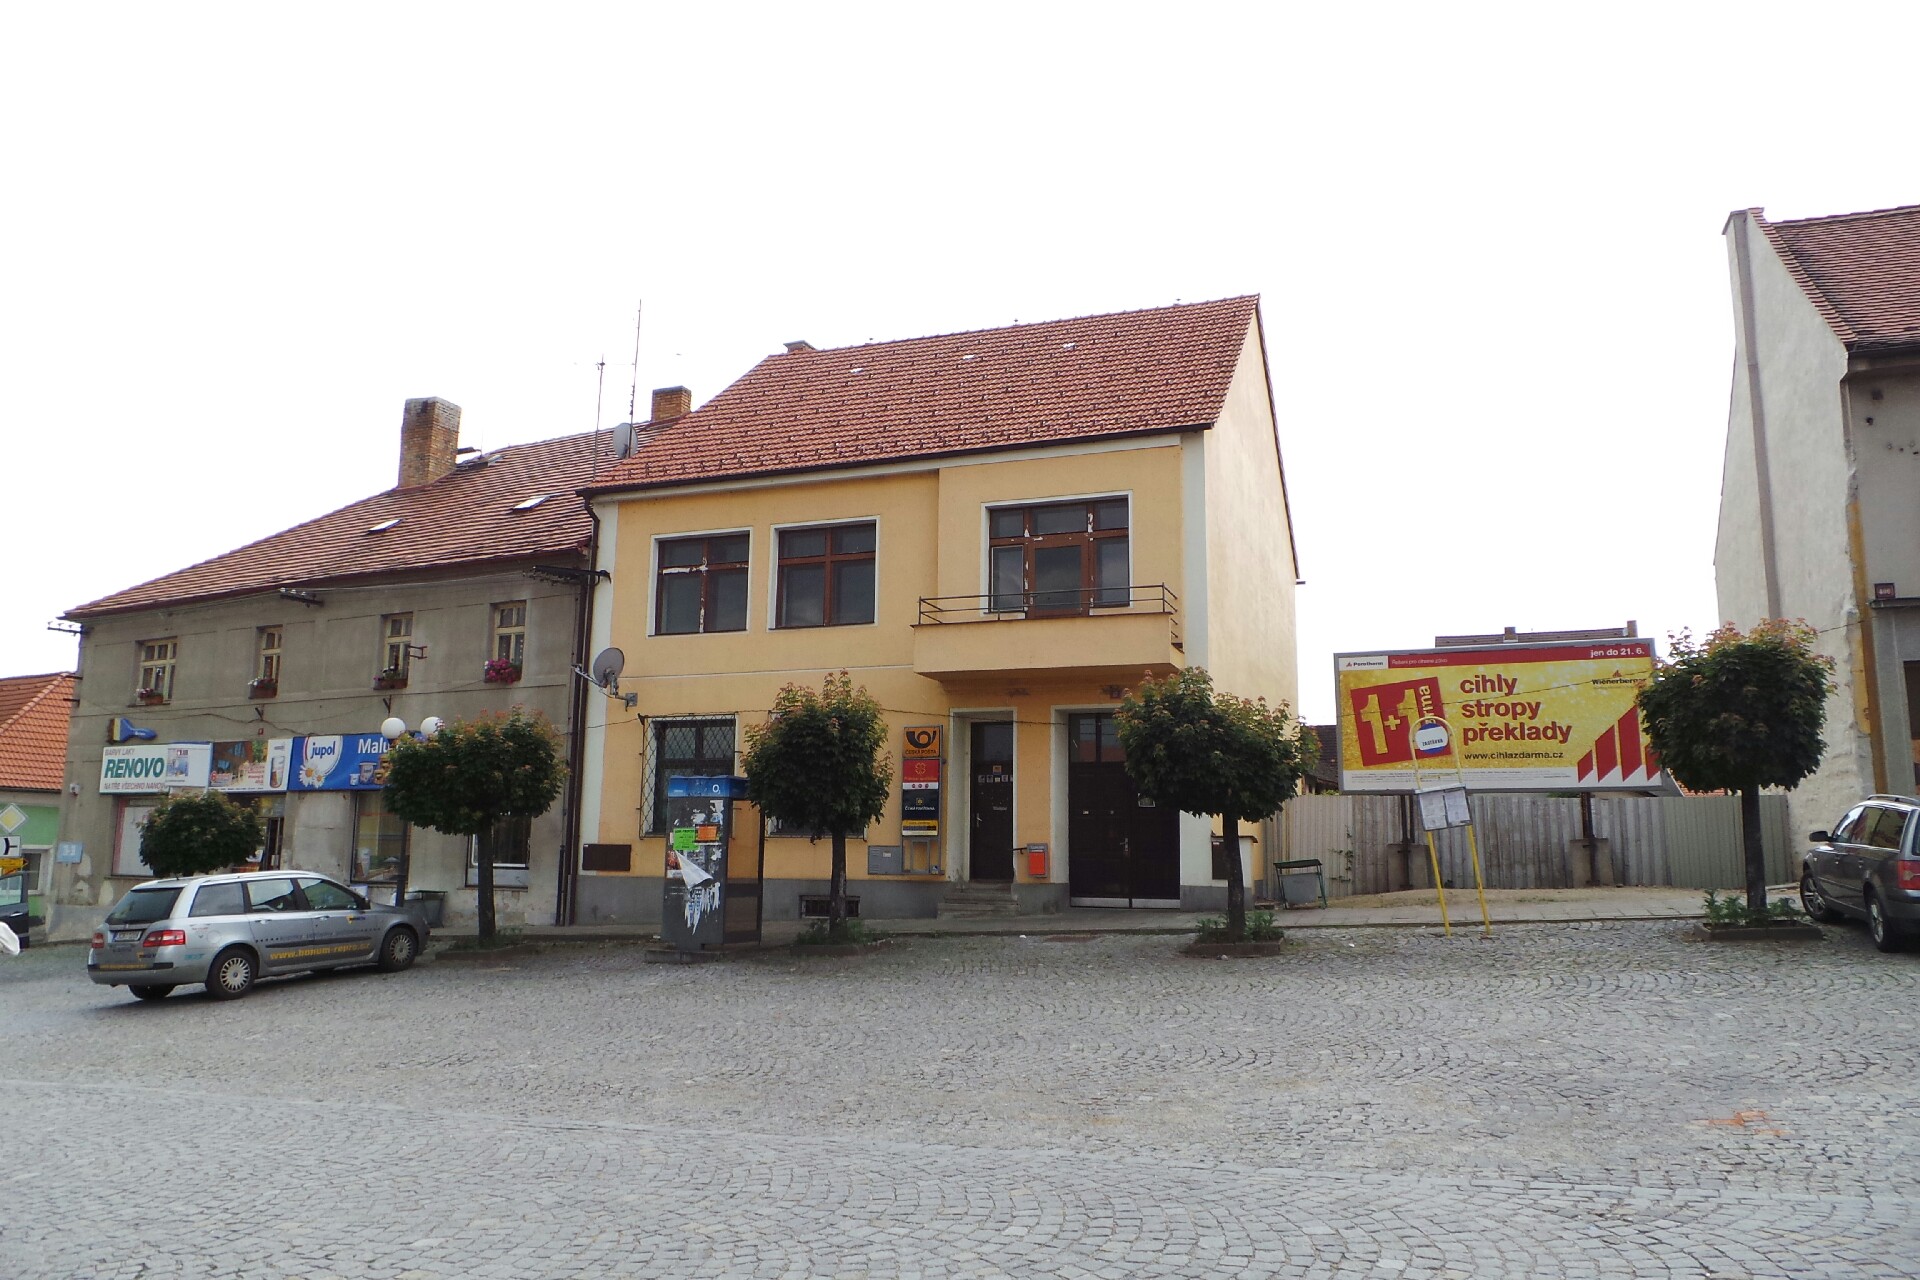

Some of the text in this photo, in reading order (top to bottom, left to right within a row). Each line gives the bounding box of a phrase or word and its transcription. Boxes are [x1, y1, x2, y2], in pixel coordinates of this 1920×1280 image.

[1590, 650, 1604, 658] jen
[1606, 648, 1618, 656] do
[1460, 674, 1517, 696] cihly
[1461, 700, 1541, 720] stropy
[1463, 721, 1572, 746] překlady
[310, 741, 336, 759] jupol
[1464, 751, 1564, 760] www.cihlazdarma.cz
[104, 757, 165, 778] RENOVO
